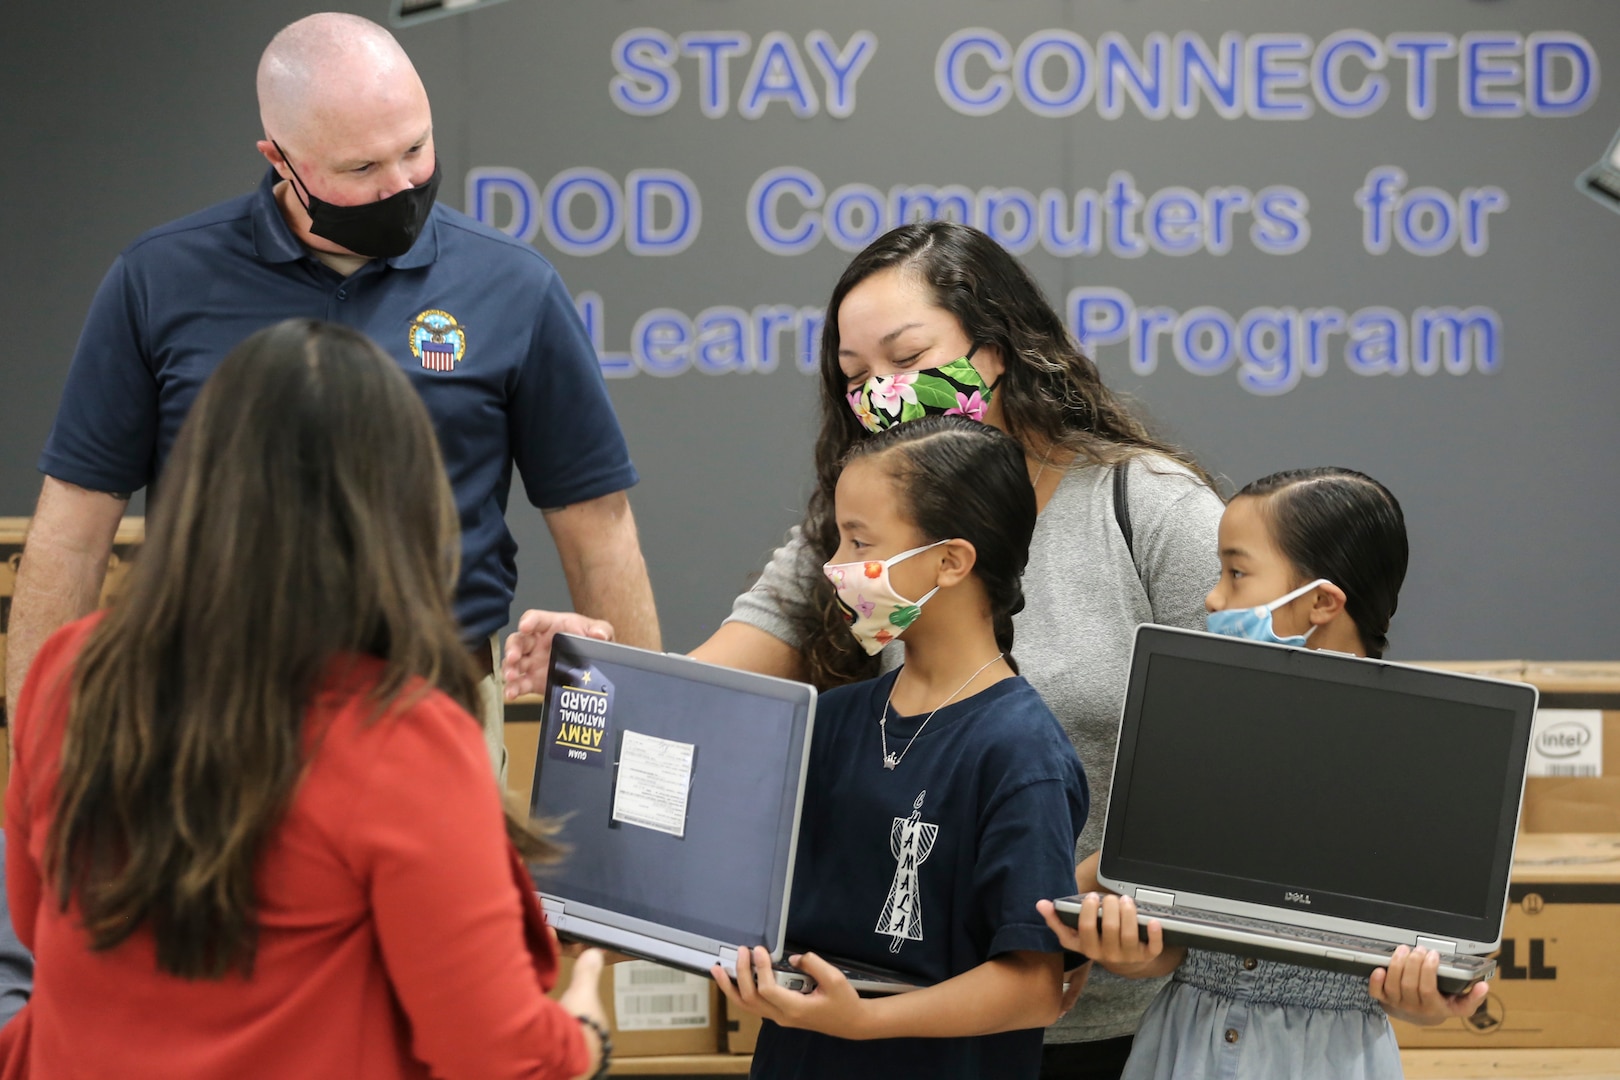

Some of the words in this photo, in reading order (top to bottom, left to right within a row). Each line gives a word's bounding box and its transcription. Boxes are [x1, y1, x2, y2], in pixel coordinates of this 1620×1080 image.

[611, 28, 877, 118] STAY
[936, 28, 1598, 119] CONNECTED
[466, 168, 700, 256] DOD
[748, 168, 1309, 257] Computers
[1356, 167, 1508, 256] for
[1067, 287, 1501, 395] Program
[560, 691, 607, 715] GUARD
[560, 708, 605, 729] NATIONAL
[557, 722, 603, 747] ARMY
[1542, 731, 1582, 747] intel
[568, 749, 587, 760] GUAM
[1285, 892, 1311, 904] DELL
